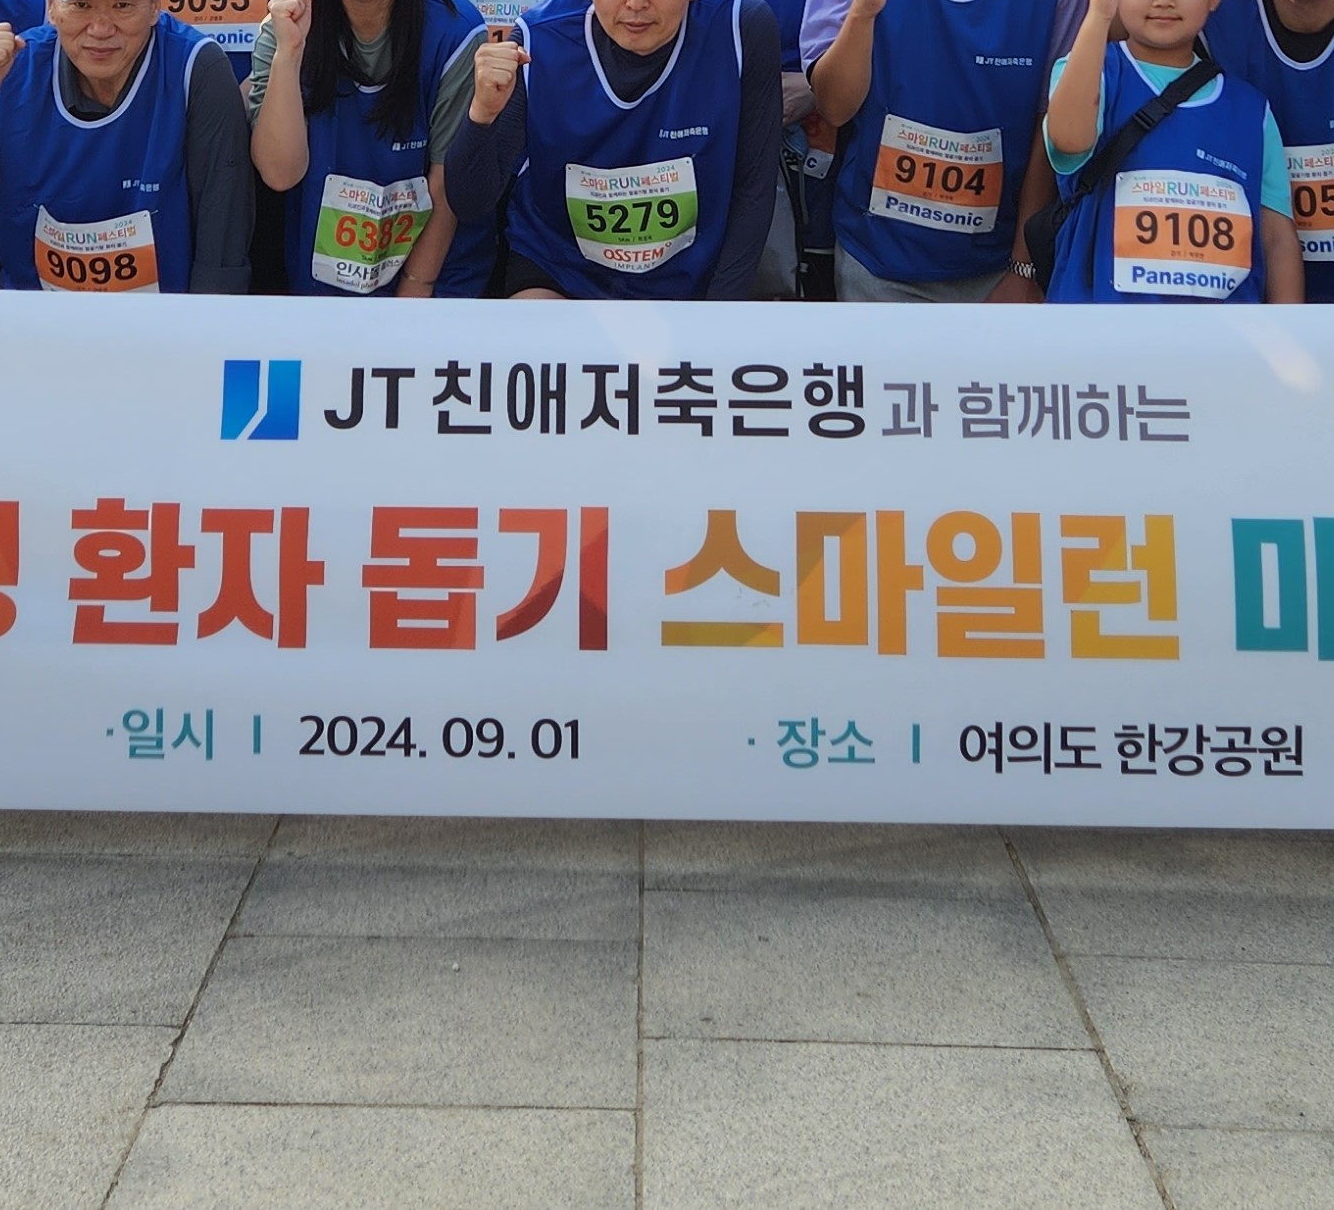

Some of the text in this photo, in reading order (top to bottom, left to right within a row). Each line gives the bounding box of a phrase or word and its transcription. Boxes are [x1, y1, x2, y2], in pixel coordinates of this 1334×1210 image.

[895, 155, 985, 196] 9104
[586, 199, 679, 234] 5279
[885, 195, 984, 227] Panasonic
[1135, 210, 1234, 251] 9108
[335, 213, 414, 252] 6382
[47, 250, 138, 284] 9098
[603, 247, 665, 263] OSSTEM
[1132, 266, 1237, 291] Panasonic
[324, 367, 415, 430] JT
[958, 381, 1190, 442] 함께하는
[68, 498, 325, 649] 환자
[362, 506, 609, 651] 돕기
[661, 510, 1180, 661] 스마일런
[299, 715, 426, 758] 2024.
[442, 717, 515, 759] 09.
[531, 718, 579, 759] 01
[777, 717, 1303, 777] 장소 여의도 한강공원
